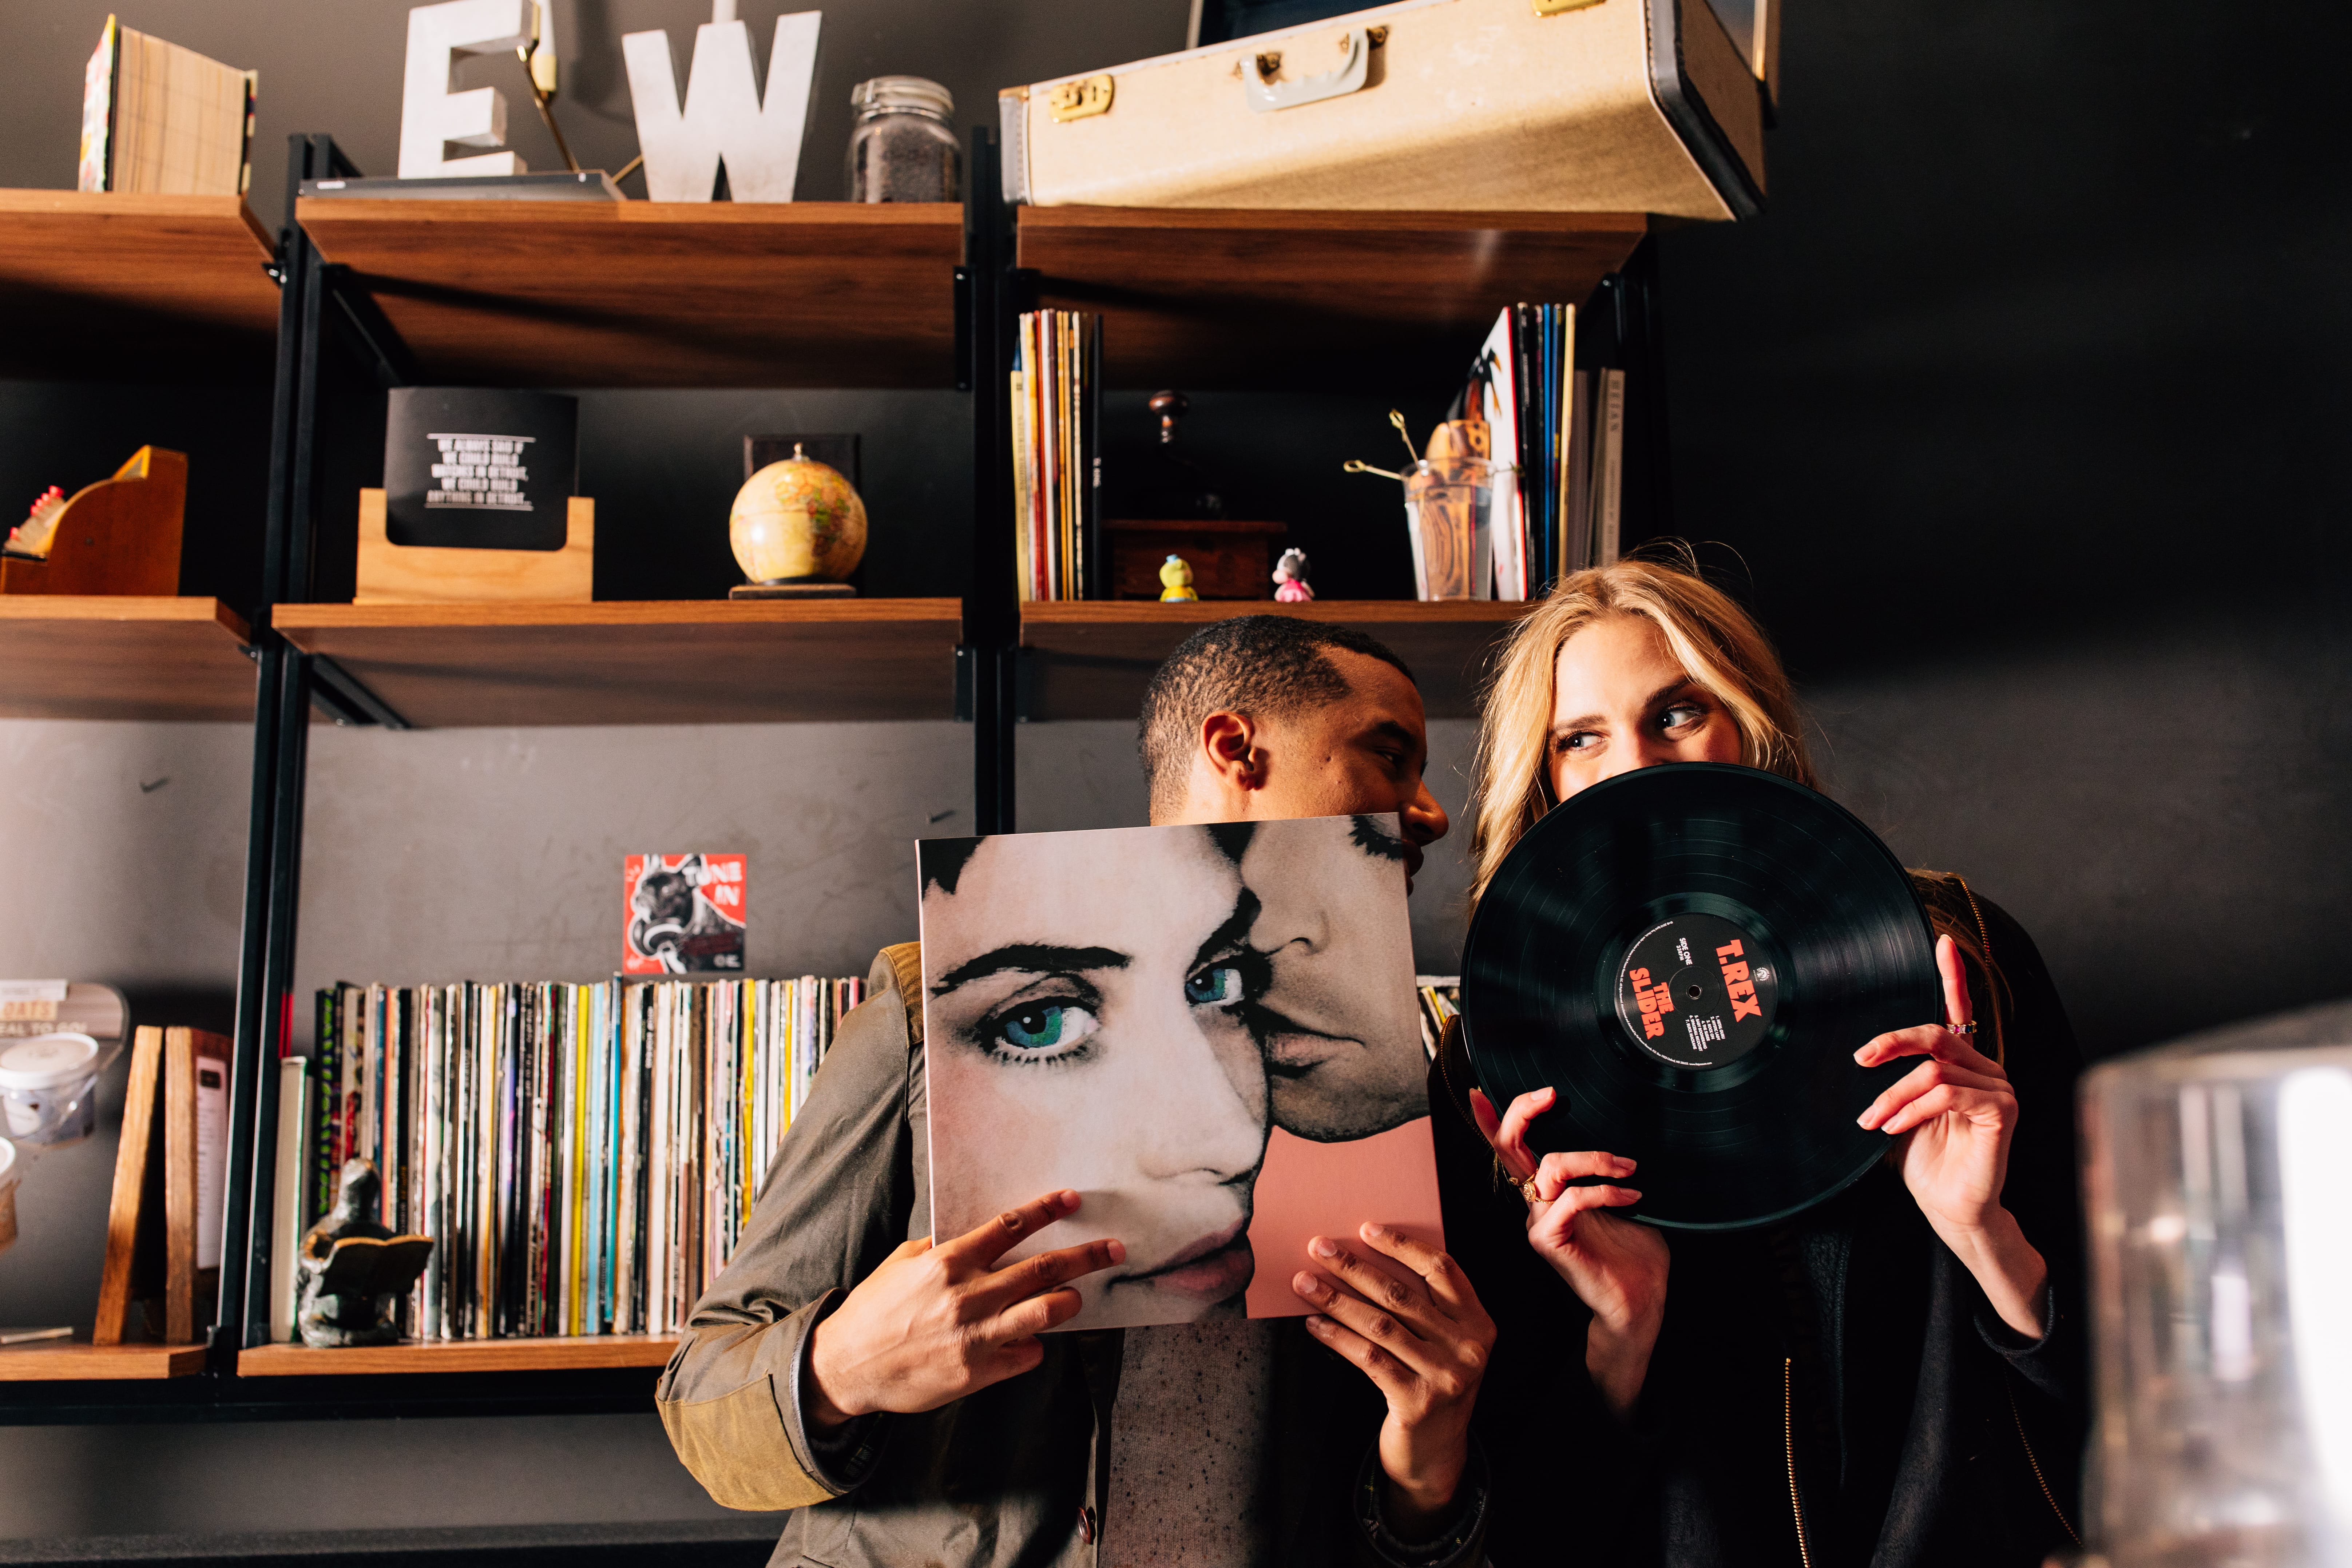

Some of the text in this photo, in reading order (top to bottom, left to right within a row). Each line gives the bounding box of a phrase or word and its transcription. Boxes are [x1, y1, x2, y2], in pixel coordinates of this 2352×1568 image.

[398, 0, 538, 179] E
[622, 10, 823, 203] W
[1679, 938, 1693, 965] SIDE ONE
[1716, 939, 1762, 1022] T.REX
[1629, 967, 1665, 1040] SLIDER
[1653, 982, 1674, 1014] THE
[1698, 1028, 1707, 1049] BOOMERANG
